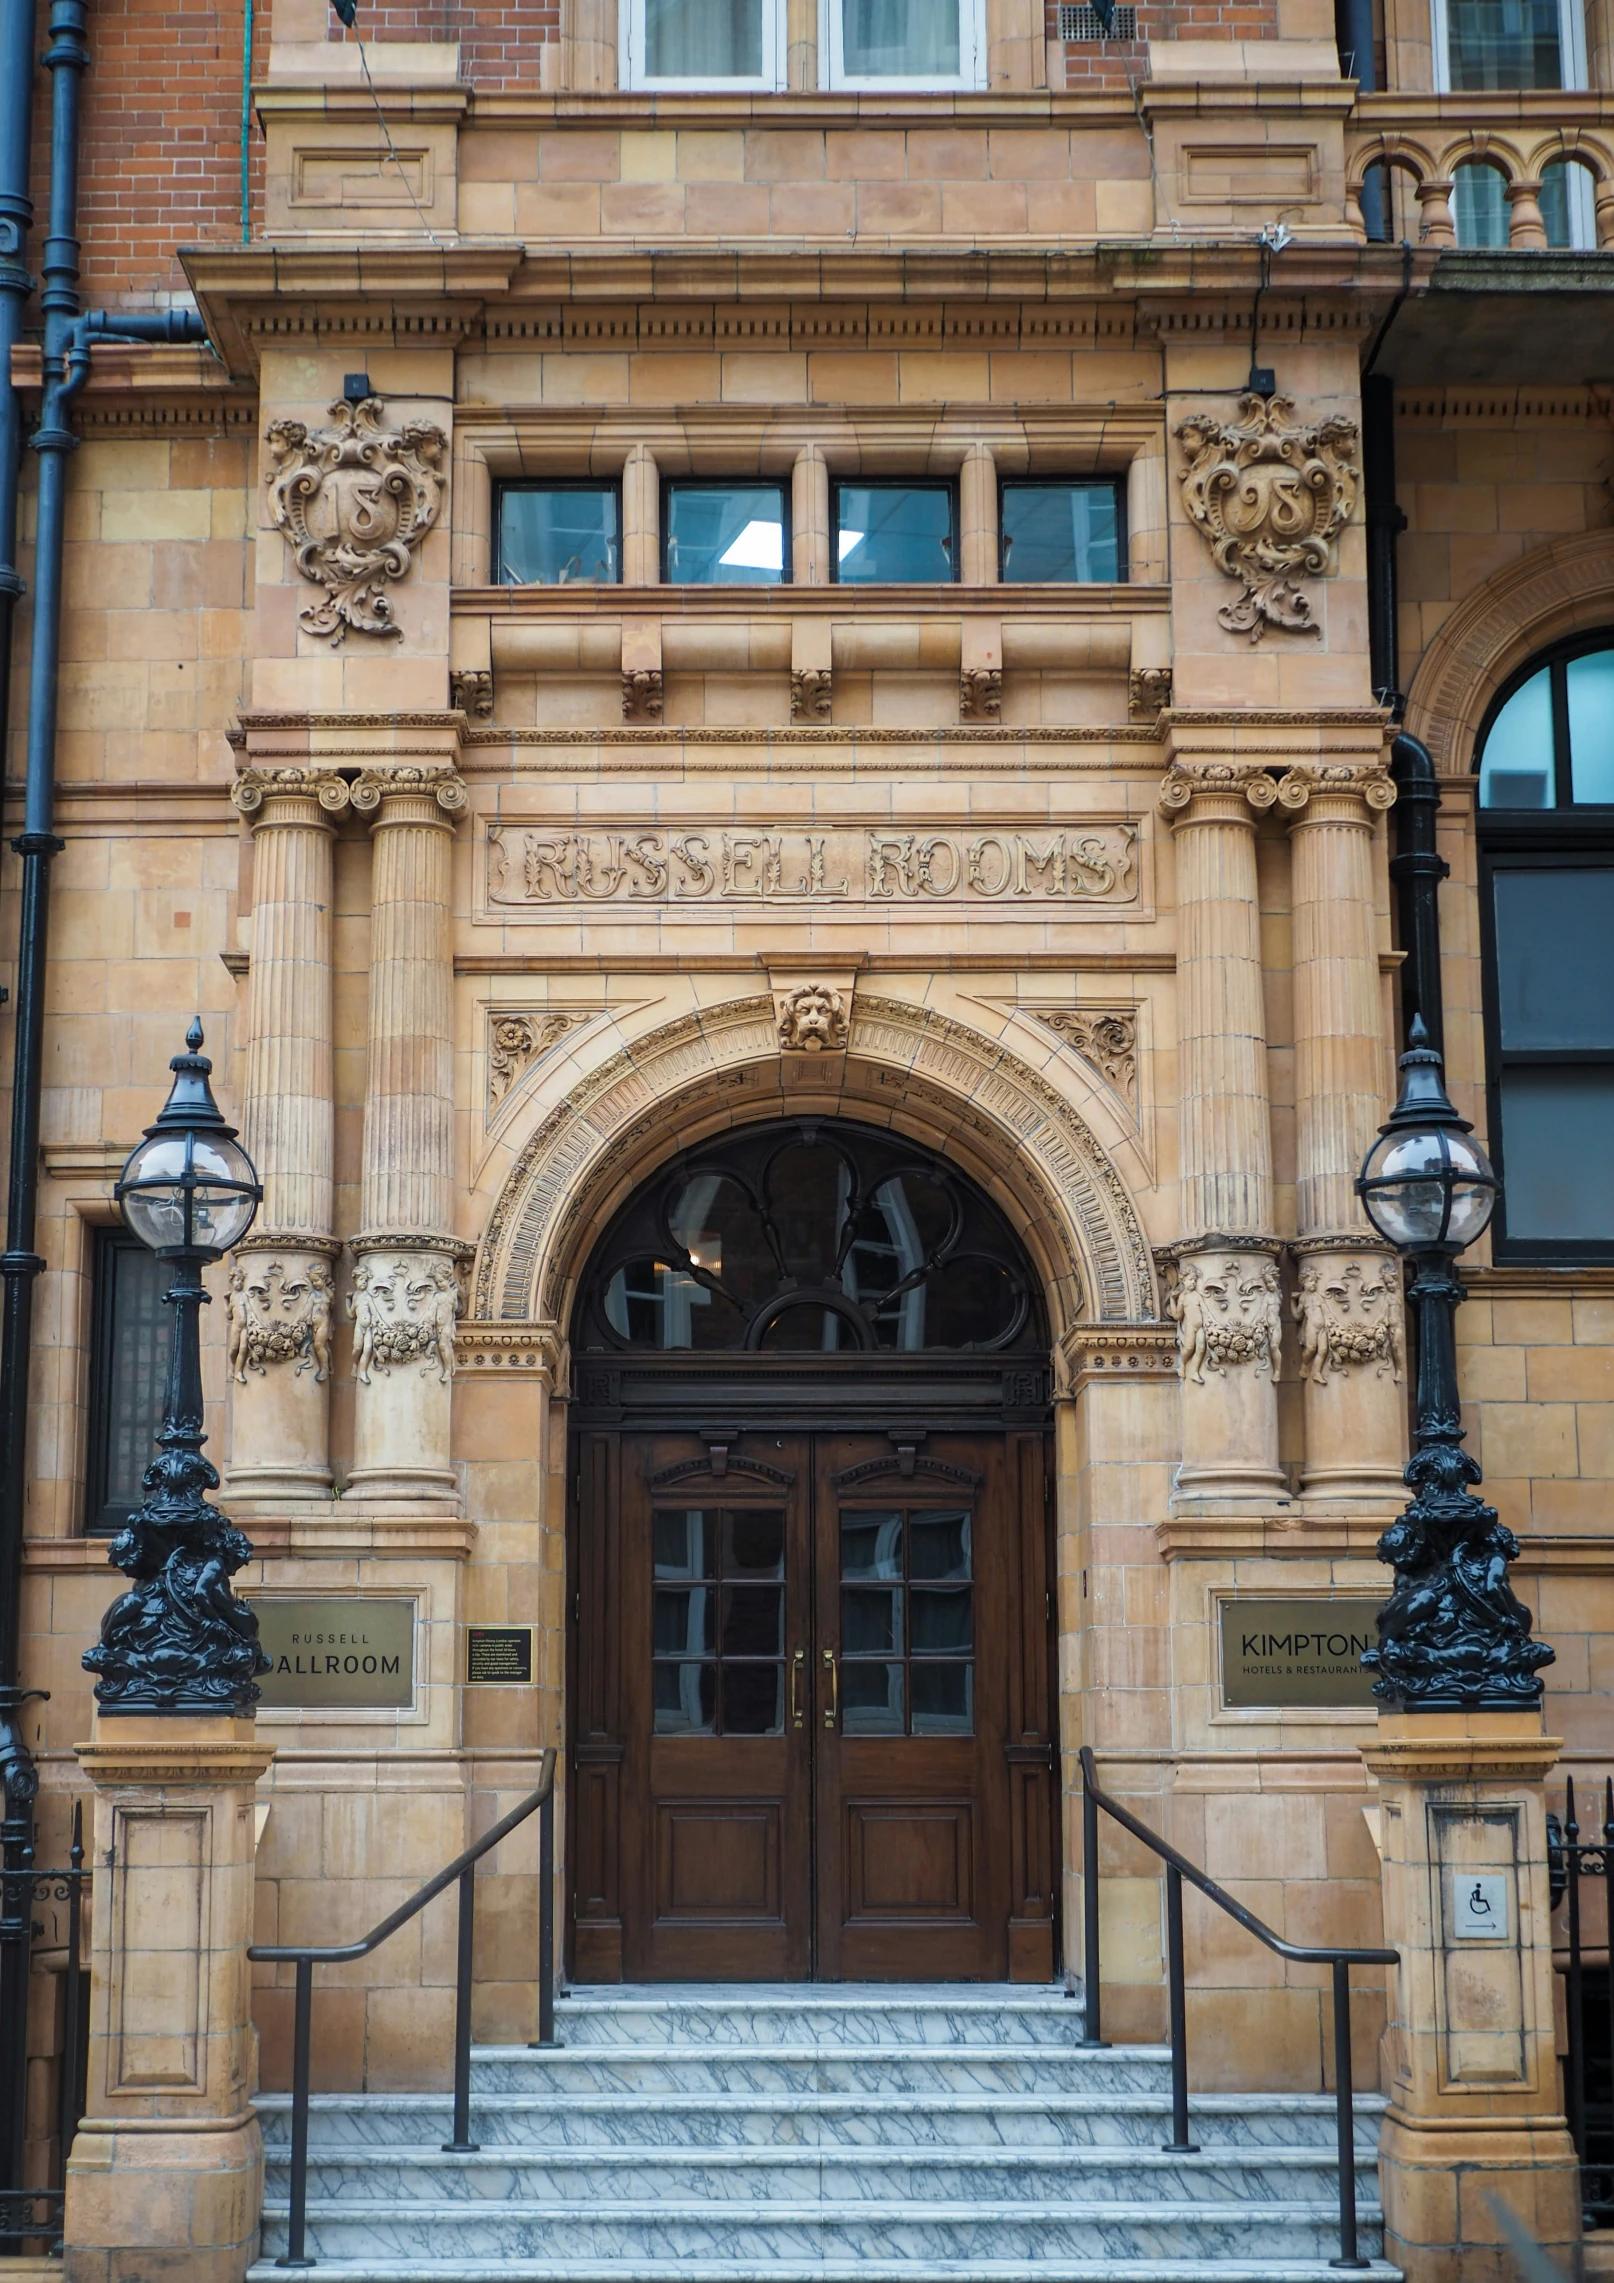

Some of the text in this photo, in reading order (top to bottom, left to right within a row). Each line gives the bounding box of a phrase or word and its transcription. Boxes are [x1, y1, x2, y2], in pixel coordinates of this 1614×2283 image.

[523, 832, 1116, 901] RUSSELL ROOMS
[292, 1633, 369, 1644] RUSSELL
[276, 1655, 400, 1674] ALLROOM
[1243, 1666, 1282, 1674] HOTELS
[1286, 1666, 1292, 1674] &
